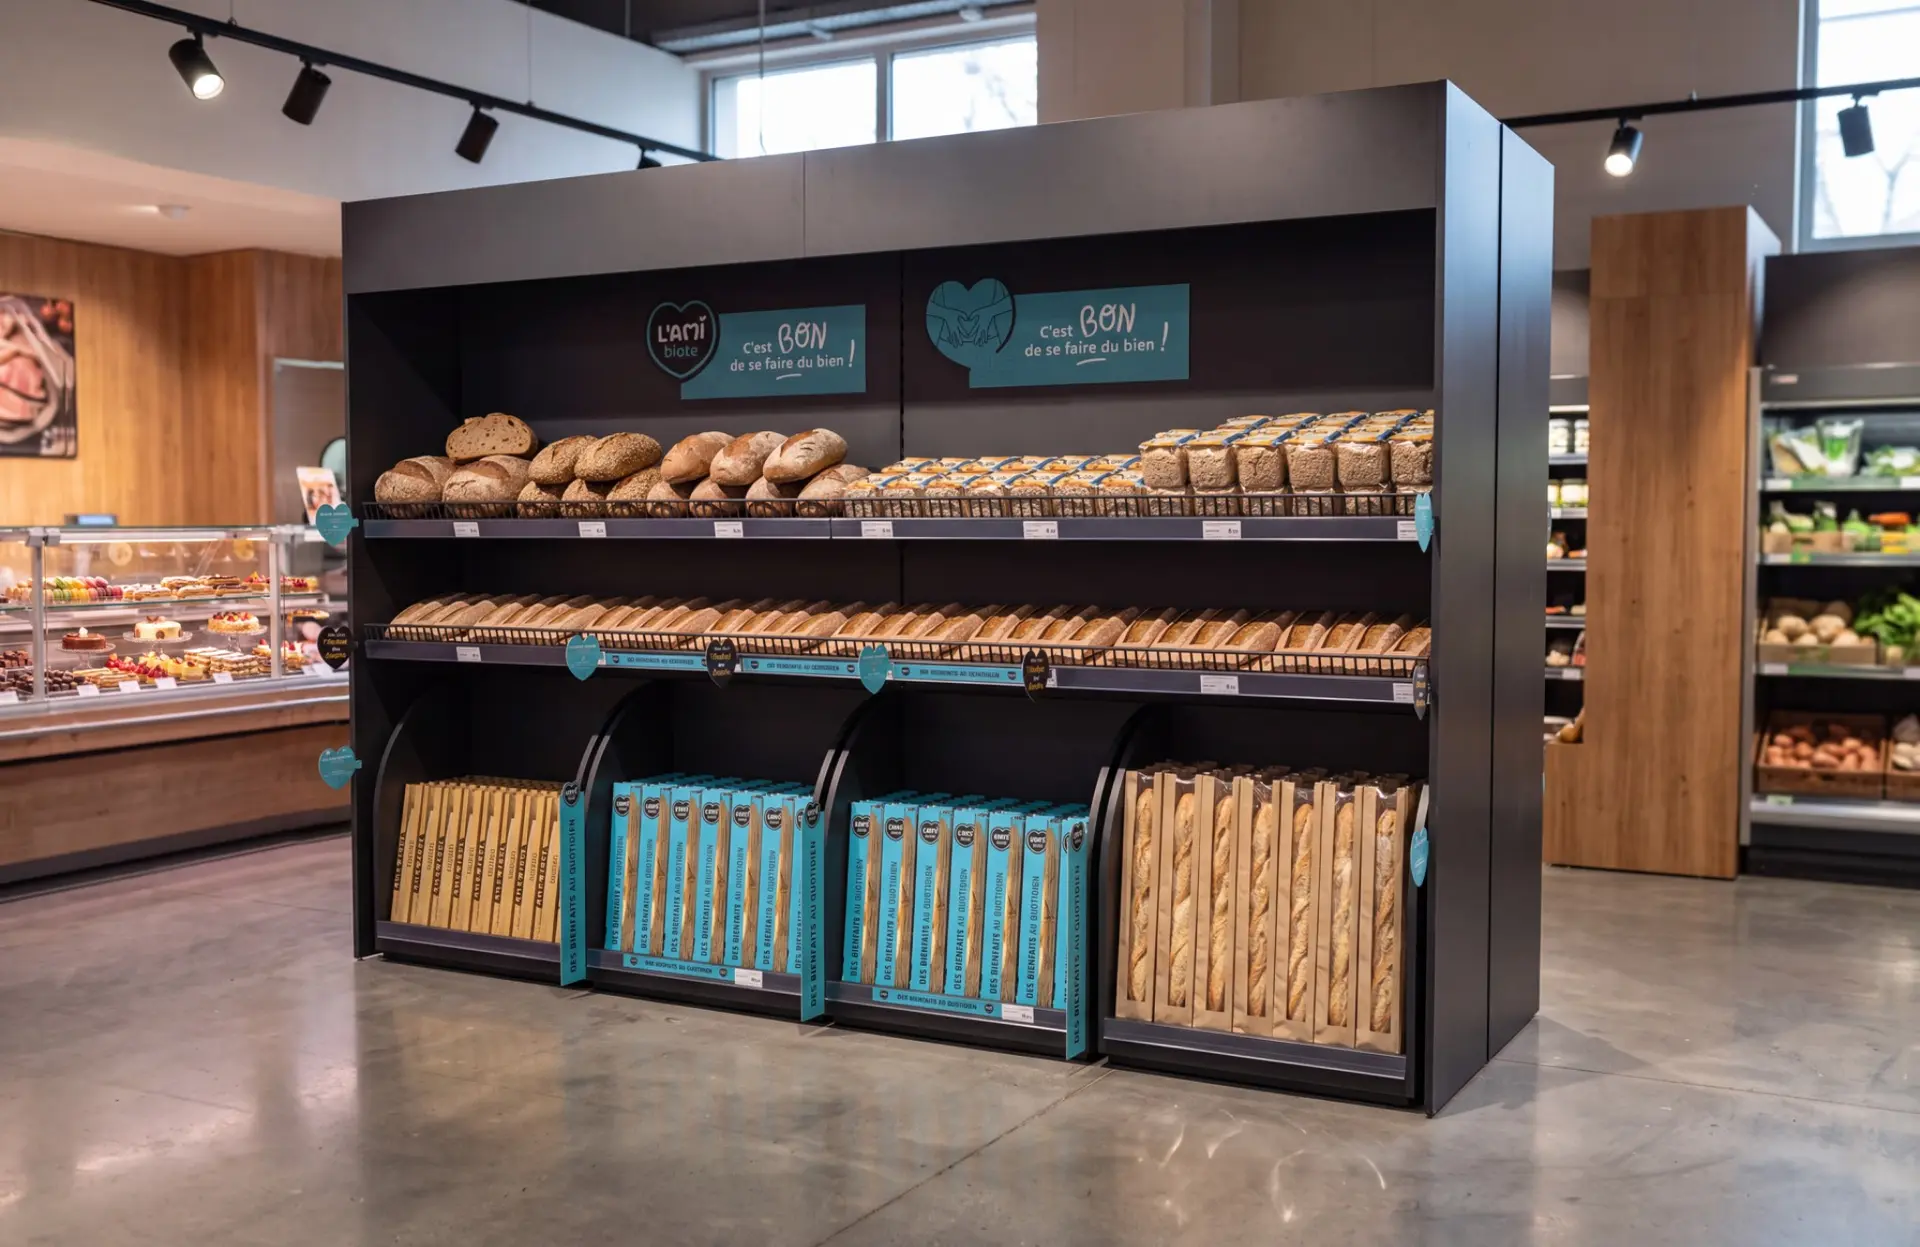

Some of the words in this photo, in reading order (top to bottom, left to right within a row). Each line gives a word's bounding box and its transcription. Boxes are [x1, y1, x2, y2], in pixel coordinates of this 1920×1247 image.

[1040, 325, 1073, 339] C'est
[1080, 303, 1136, 338] BON
[664, 344, 698, 358] biote
[743, 342, 772, 354] C'est
[778, 322, 827, 353] BON
[1025, 344, 1041, 357] de
[1046, 345, 1060, 356] se
[1065, 341, 1096, 355] faire
[1101, 340, 1118, 353] du
[1124, 338, 1154, 352] bien
[1160, 321, 1169, 351] !
[730, 360, 744, 371] de
[749, 360, 762, 370] se
[765, 356, 793, 370] faire
[798, 356, 813, 368] du
[817, 354, 843, 368] bien
[848, 339, 855, 367] !
[568, 878, 576, 891] AU
[809, 841, 817, 900] QUOTIDIEN
[568, 895, 576, 949] BIENFAITS
[809, 903, 817, 919] AU
[568, 953, 576, 972] DES
[809, 924, 817, 981] BIENFAITS
